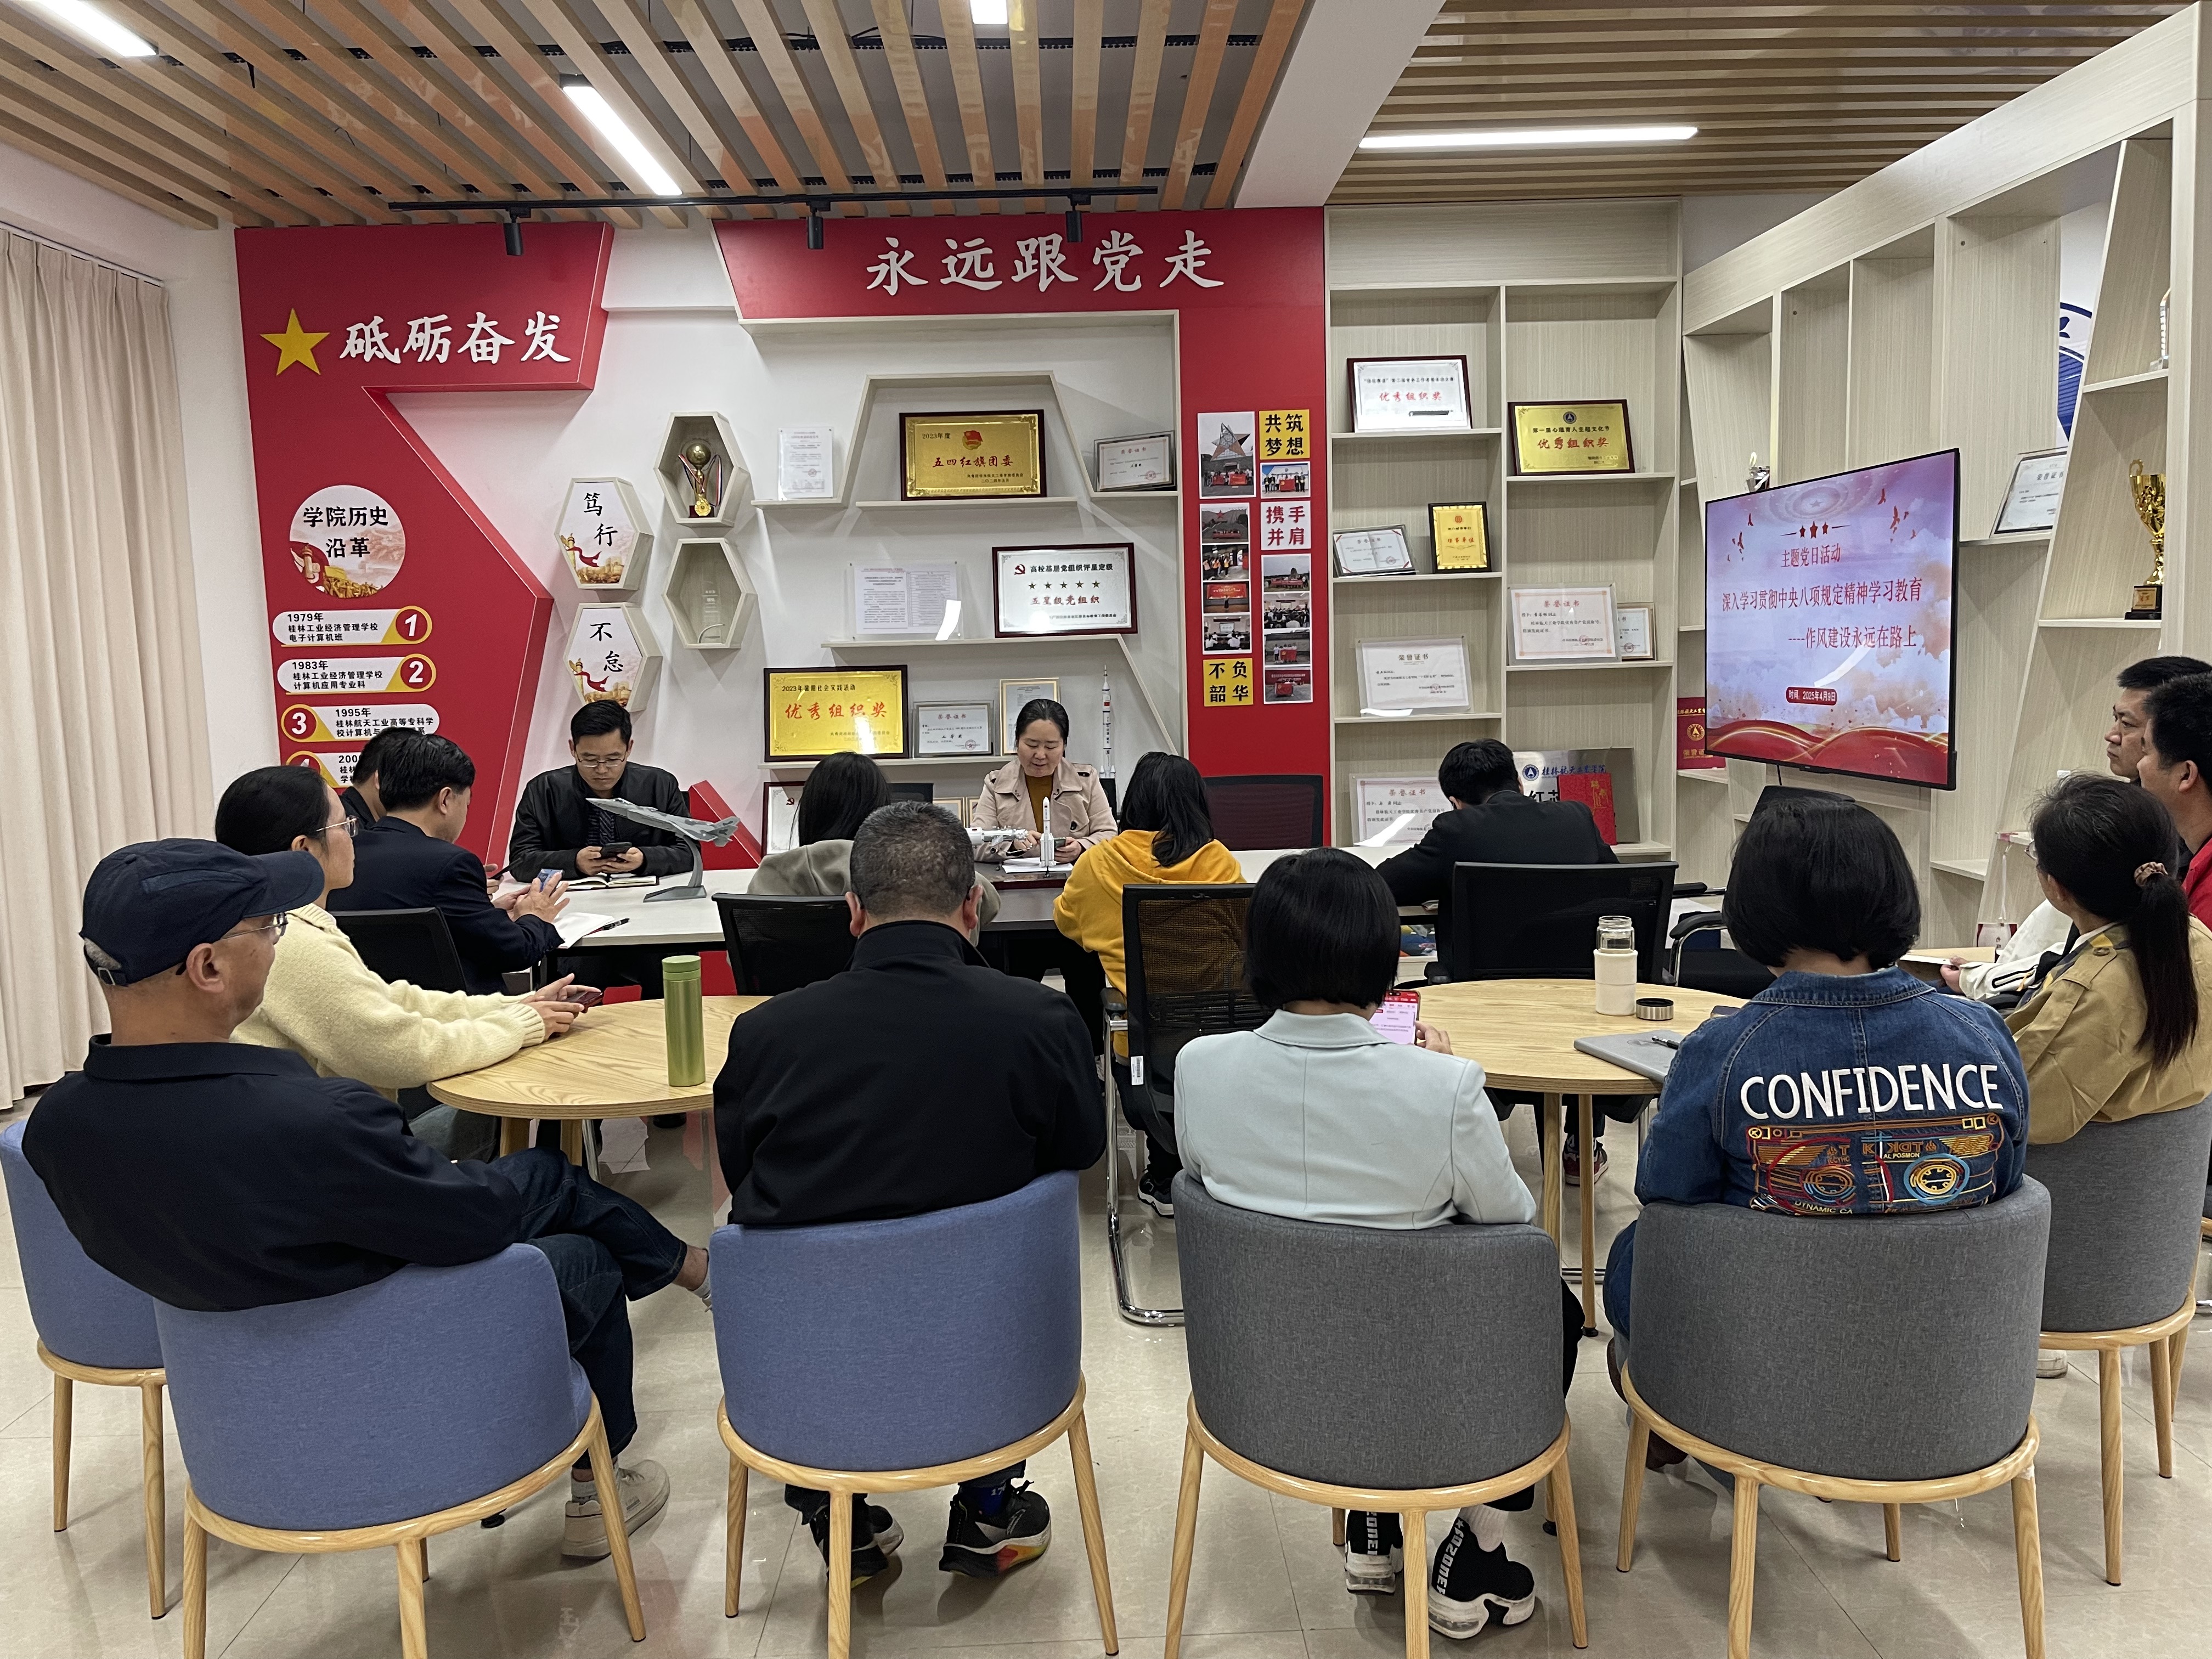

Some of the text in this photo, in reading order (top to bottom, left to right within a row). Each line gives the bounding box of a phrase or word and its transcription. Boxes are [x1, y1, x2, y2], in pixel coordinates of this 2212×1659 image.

[867, 230, 1224, 295] 永远跟党走
[340, 311, 571, 364] 砥砺奋发
[1265, 414, 1304, 433] 共筑
[1265, 437, 1304, 456] 梦想
[1537, 437, 1609, 450] 优秀组织奖
[933, 455, 1013, 468] 五四红旗团委
[303, 506, 388, 527] 学院历史
[584, 492, 618, 546] 笃行
[1266, 506, 1305, 524] 携手
[1268, 527, 1305, 546] 并肩
[326, 537, 370, 557] 沿革
[1781, 543, 1841, 568] 主题党日活动
[1030, 595, 1100, 606] 五星级党组织
[1722, 577, 1922, 612] 深入学习贯彻中央八项规定精神学习教育
[287, 612, 324, 622] 1979年
[405, 614, 417, 636] 1
[288, 623, 378, 633] 桂林工业经济管理学校
[289, 633, 343, 642] 电子计算机班
[589, 622, 623, 672] 不怠
[292, 660, 328, 670] 1983年
[409, 661, 424, 682] 2
[1209, 661, 1248, 679] 不负
[293, 670, 383, 680] 桂林工业经济管理学校
[294, 680, 365, 690] 计算机应用专业科
[1210, 685, 1249, 702] 韶华
[336, 708, 371, 717] 1995年
[785, 701, 887, 720] 优秀组织奖
[291, 712, 306, 734] 3
[336, 717, 433, 727] 桂林航天工业高等专科学
[338, 755, 360, 763] 200
[1740, 1063, 2003, 1119] CONFIDENCE
